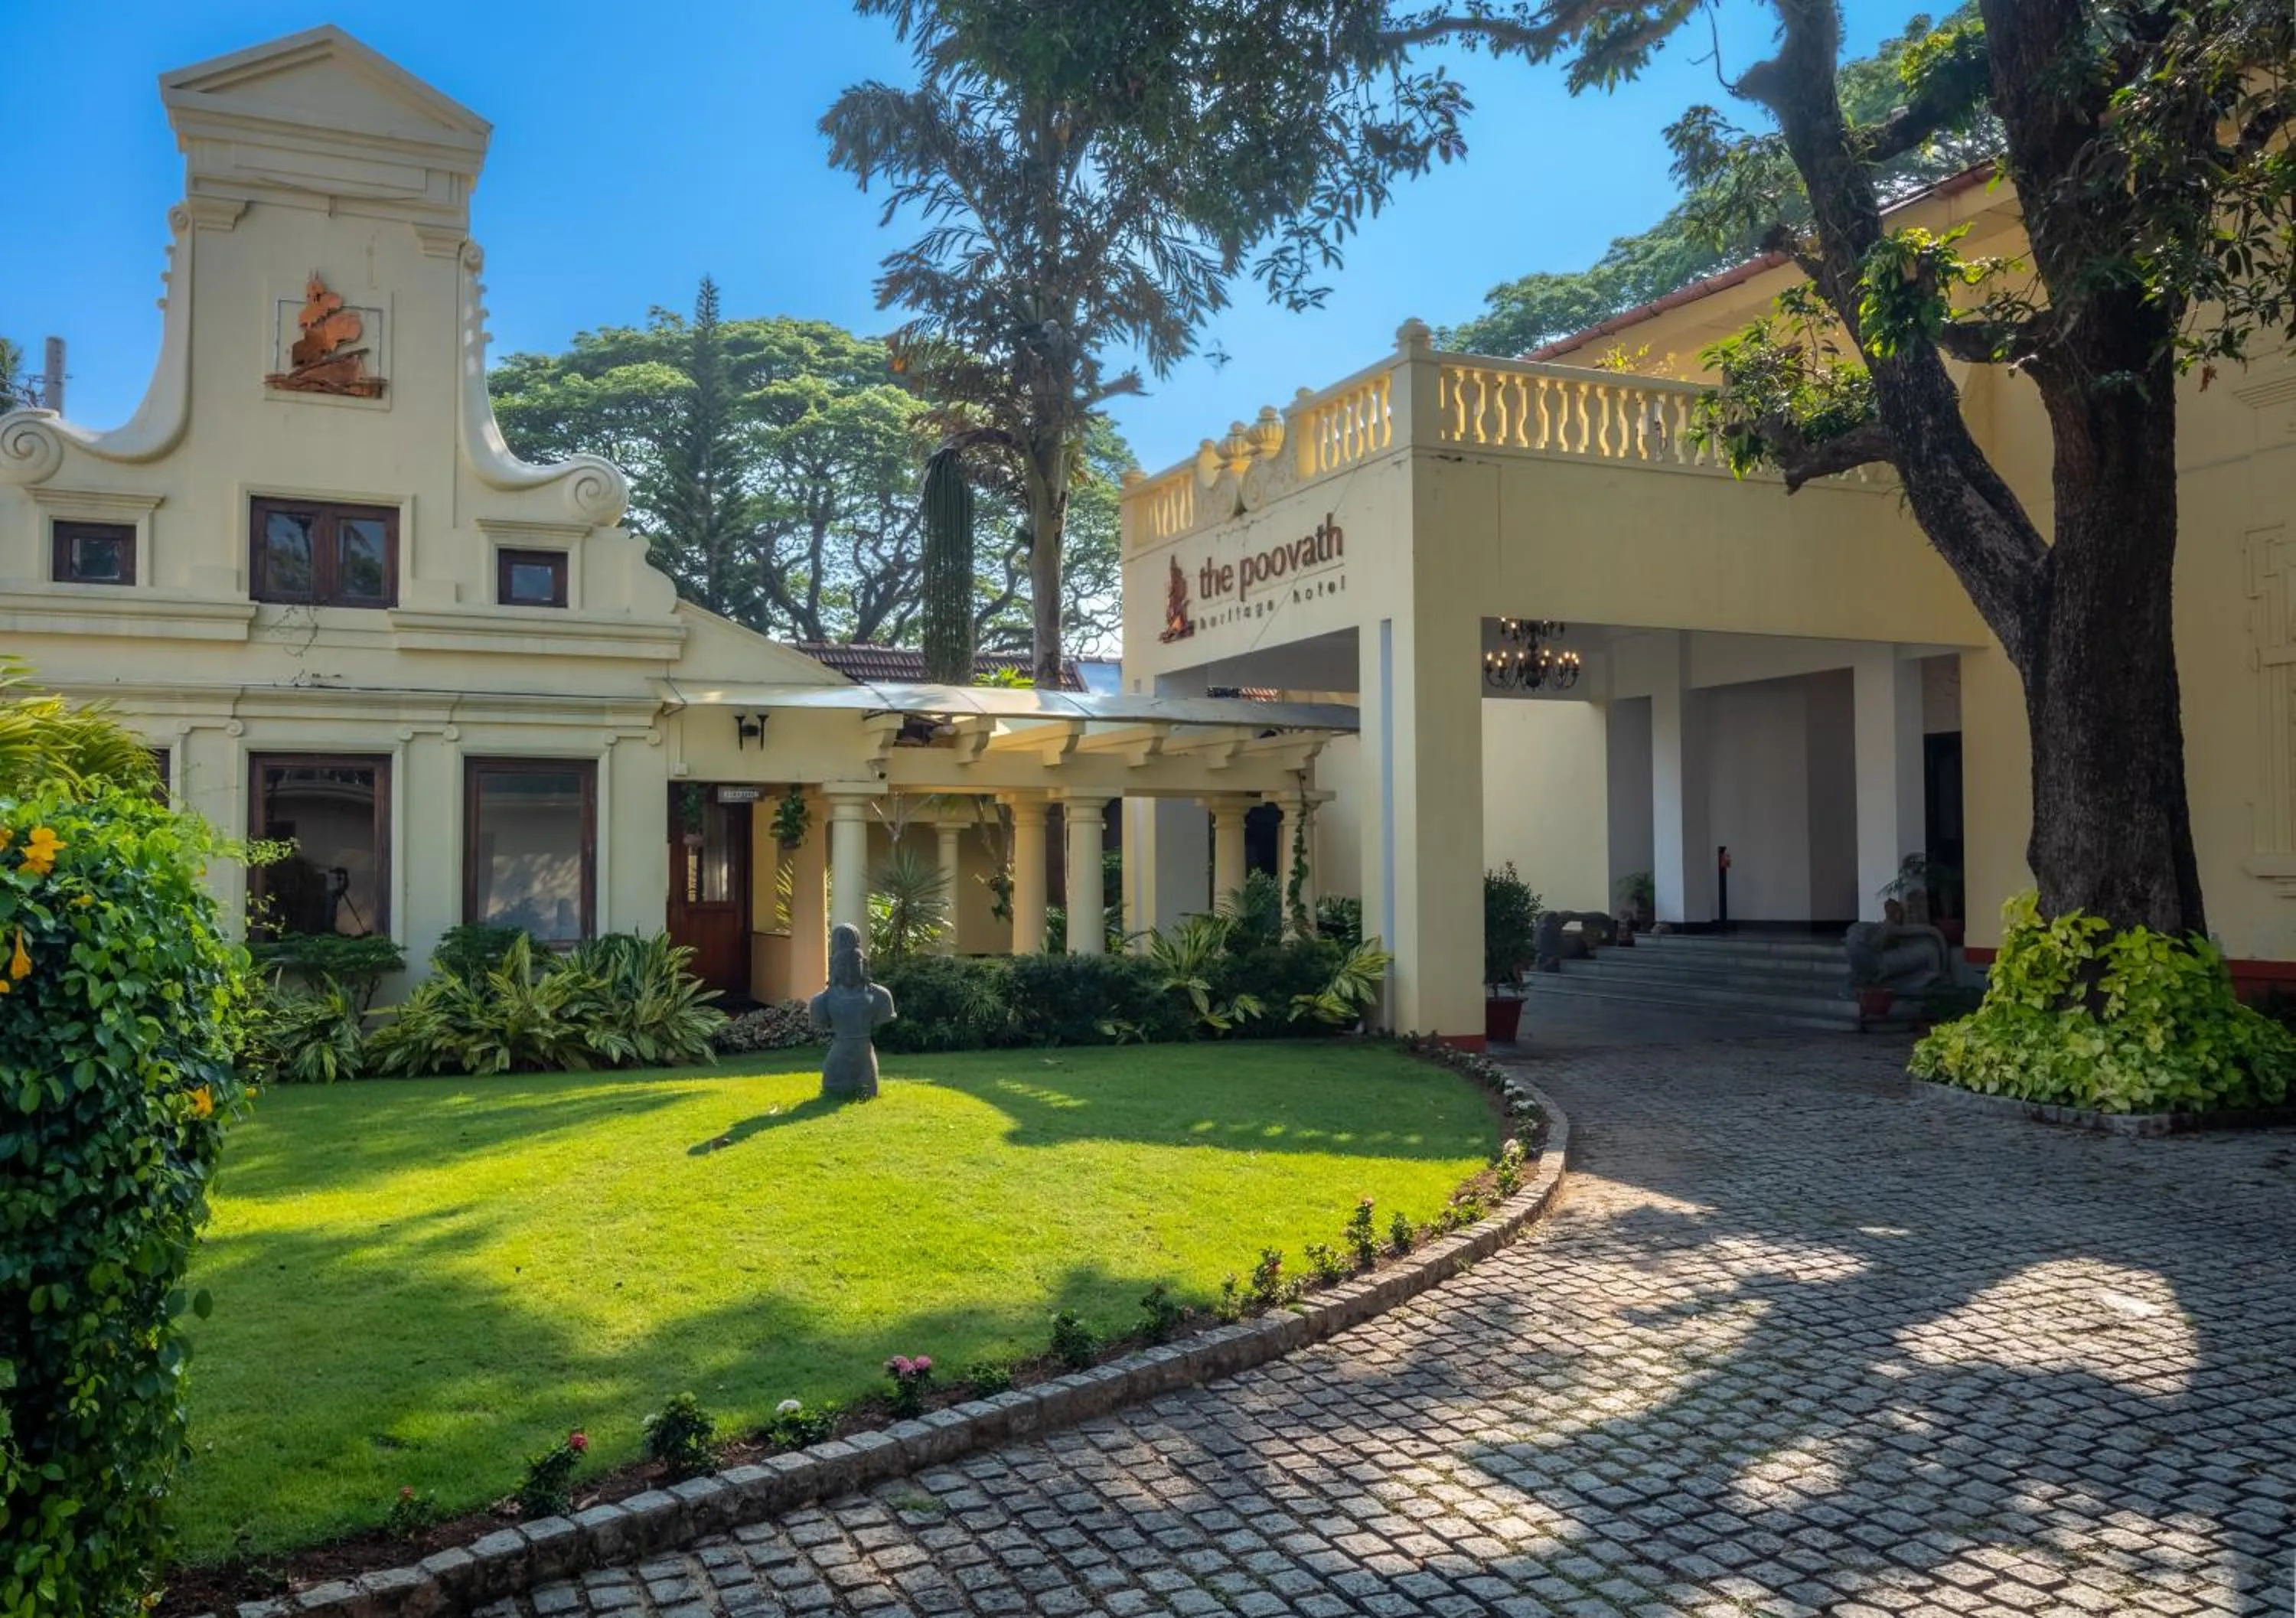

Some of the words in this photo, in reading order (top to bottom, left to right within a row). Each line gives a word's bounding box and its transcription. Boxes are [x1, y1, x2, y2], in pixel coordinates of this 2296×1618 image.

[1199, 556, 1233, 599] the
[1240, 512, 1343, 602] poovath
[1293, 575, 1345, 604] hotel
